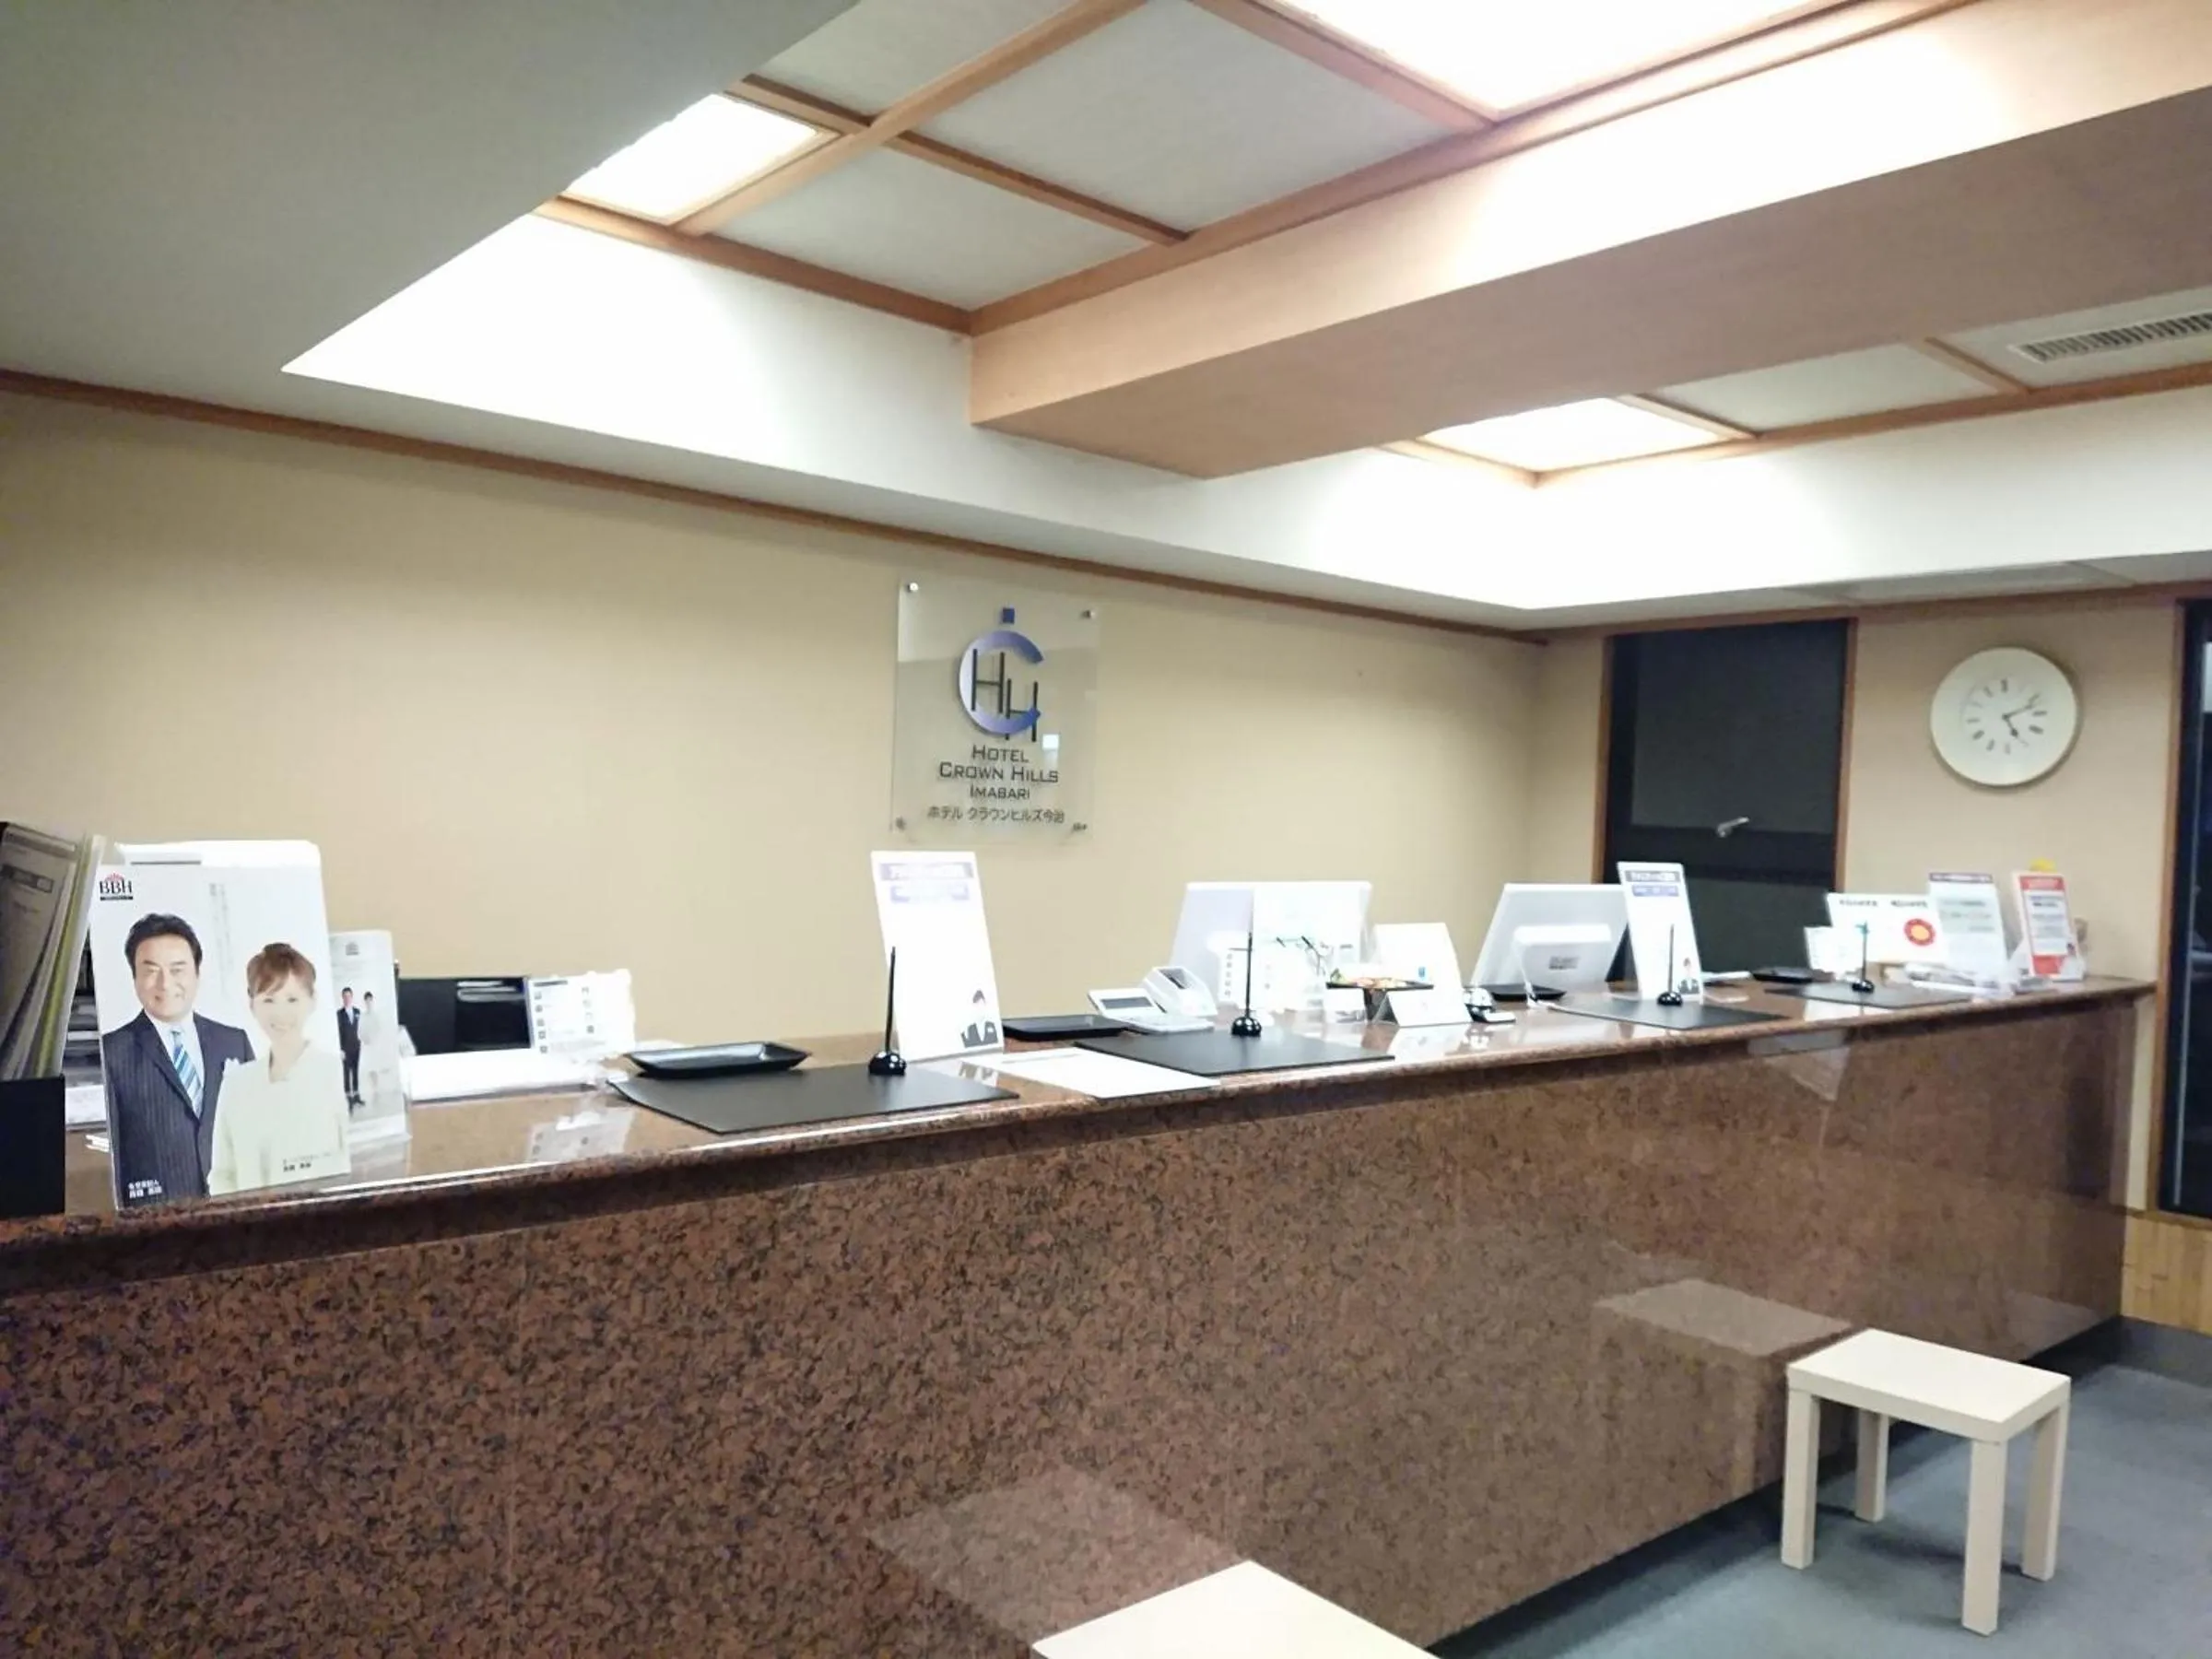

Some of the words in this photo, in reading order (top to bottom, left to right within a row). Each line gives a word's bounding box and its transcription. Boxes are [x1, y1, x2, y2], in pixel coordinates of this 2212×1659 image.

[971, 744, 1030, 763] HOTEL
[939, 761, 1004, 781] CROWN
[1010, 764, 1059, 783] HILLS
[970, 784, 1030, 800] IMABARI
[100, 878, 133, 894] BBH
